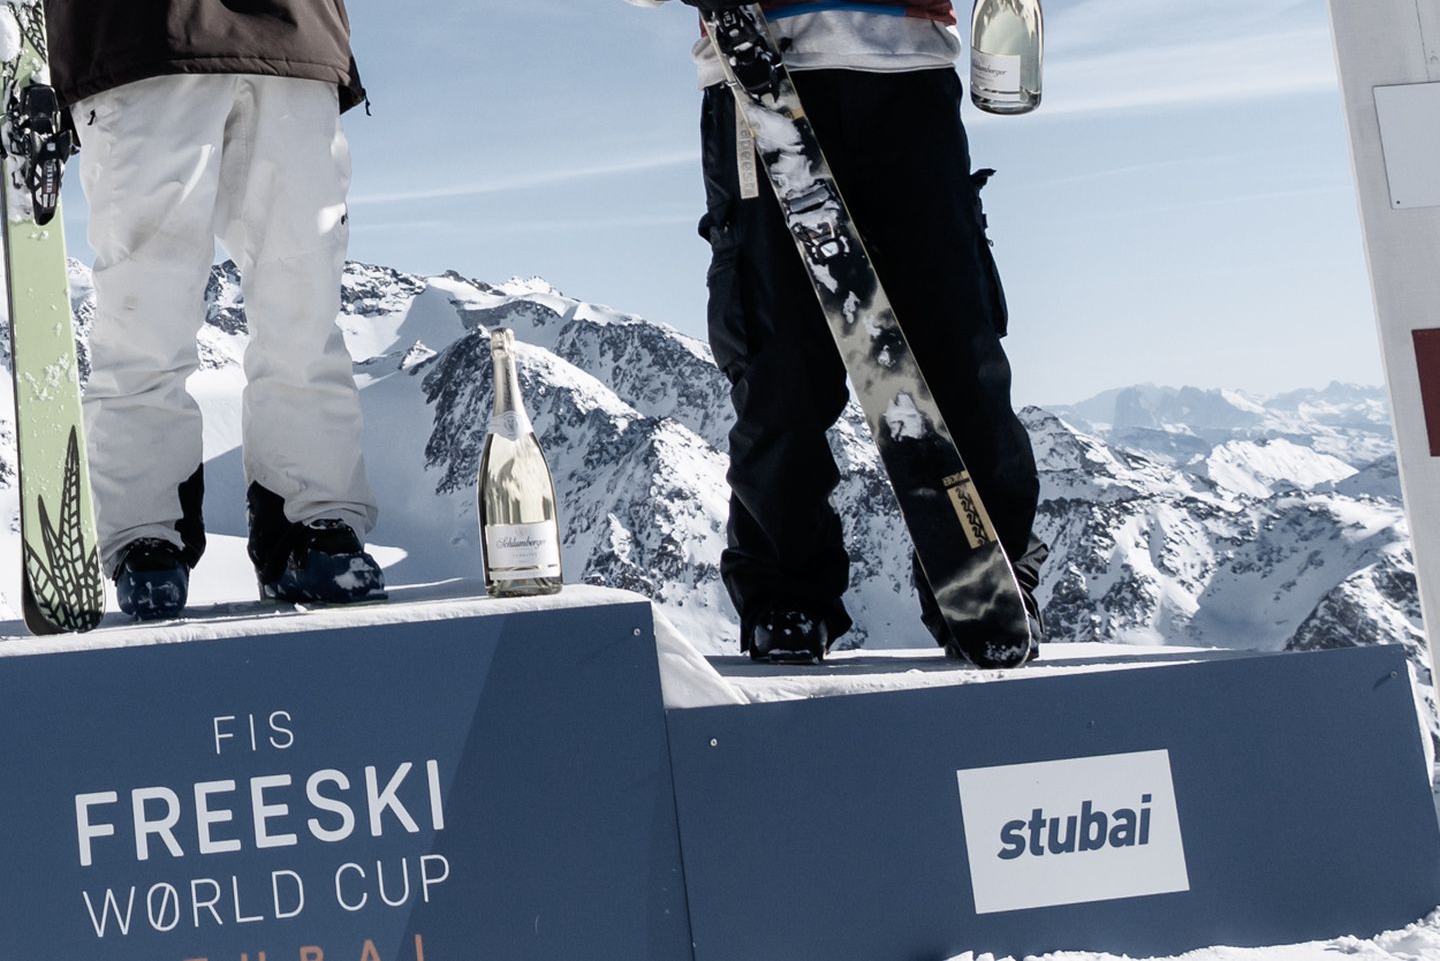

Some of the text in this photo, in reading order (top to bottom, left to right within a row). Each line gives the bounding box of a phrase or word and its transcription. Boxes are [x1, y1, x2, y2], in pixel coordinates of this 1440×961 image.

[213, 710, 294, 754] FIS
[74, 759, 444, 866] FREESKI
[997, 793, 1152, 861] stubai
[334, 854, 450, 912] CUP
